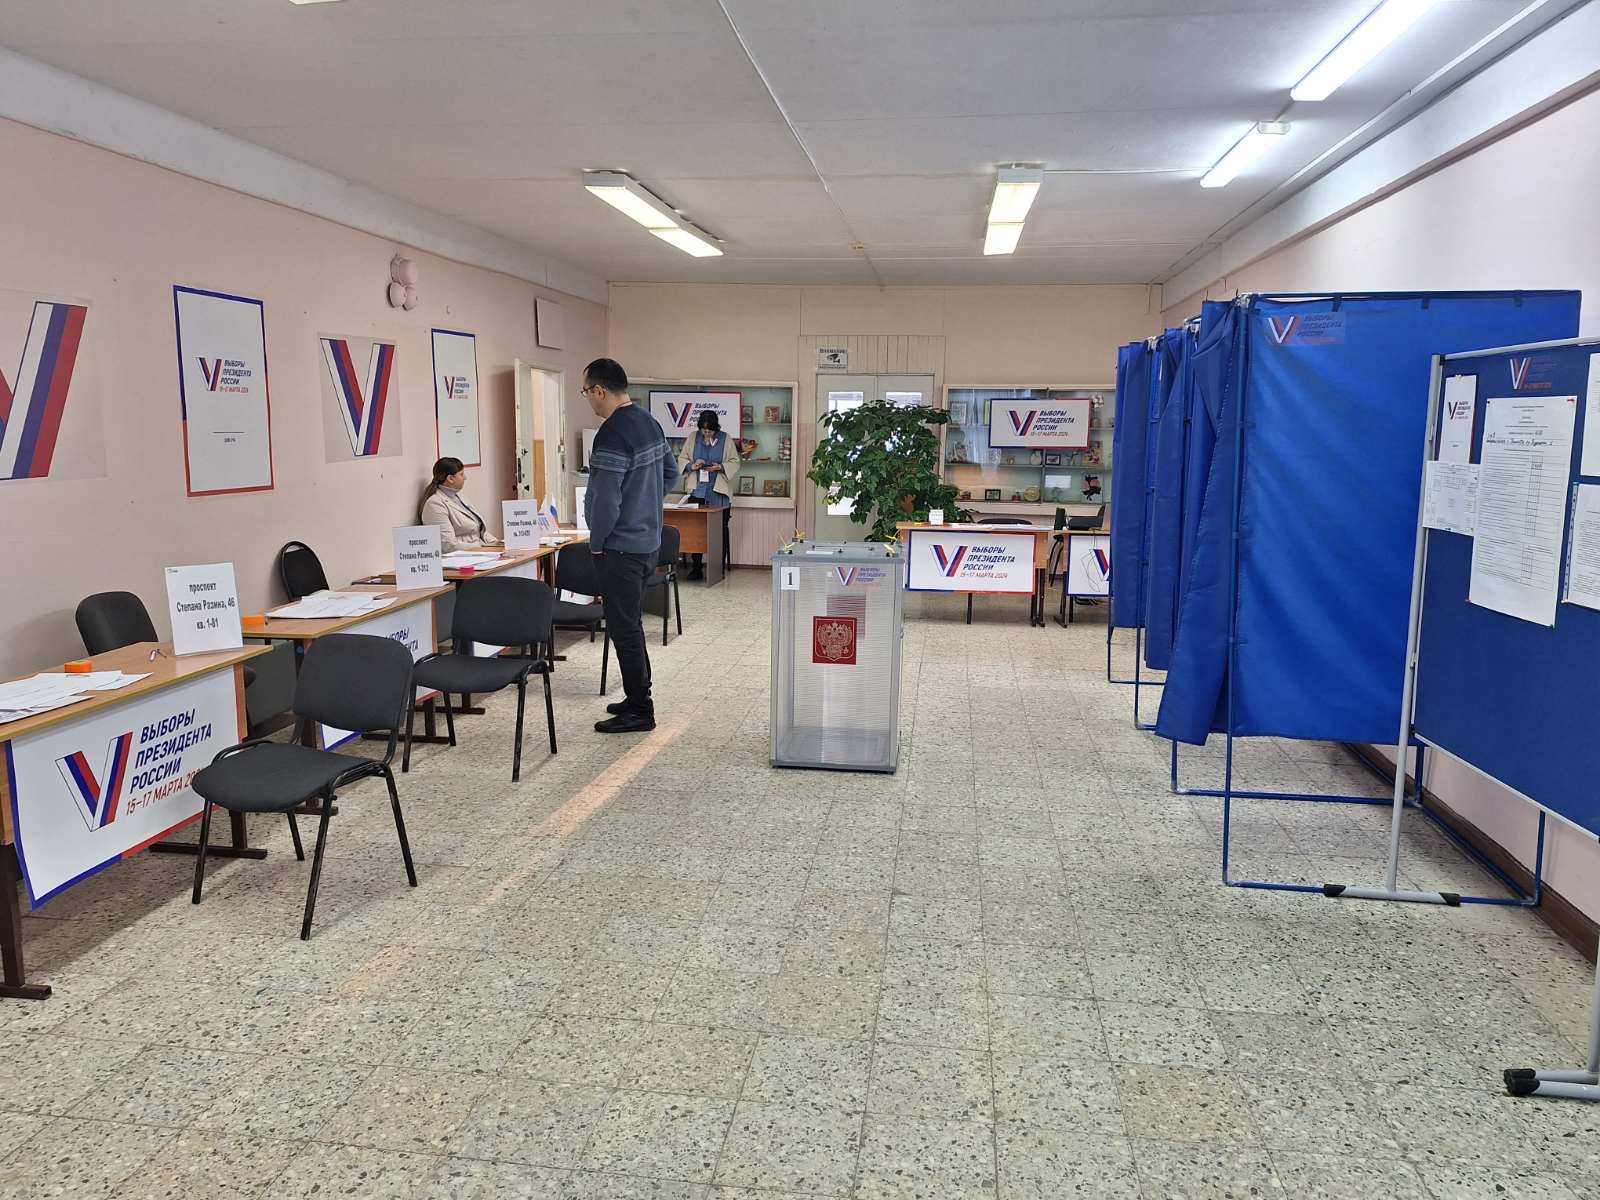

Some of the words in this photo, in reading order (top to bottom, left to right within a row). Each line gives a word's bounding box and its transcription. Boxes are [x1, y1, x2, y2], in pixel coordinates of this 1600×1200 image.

[220, 377, 240, 385] РОССИИ
[408, 538, 428, 549] проспект
[971, 546, 1006, 554] ВЫБОРЫ
[399, 552, 417, 560] Степана
[966, 554, 1016, 563] ПРЕЗИДЕНТА
[962, 563, 994, 571] РОССИИ
[787, 571, 793, 586] 1
[188, 582, 217, 594] проспект
[176, 600, 202, 613] Степана
[202, 599, 227, 611] Разина,
[196, 621, 206, 630] кв.
[140, 708, 196, 745] ВЫБОРЫ
[134, 722, 212, 769] ПРЕЗИДЕНТА
[129, 756, 182, 795] РОССИИ
[153, 776, 183, 803] МАРТА
